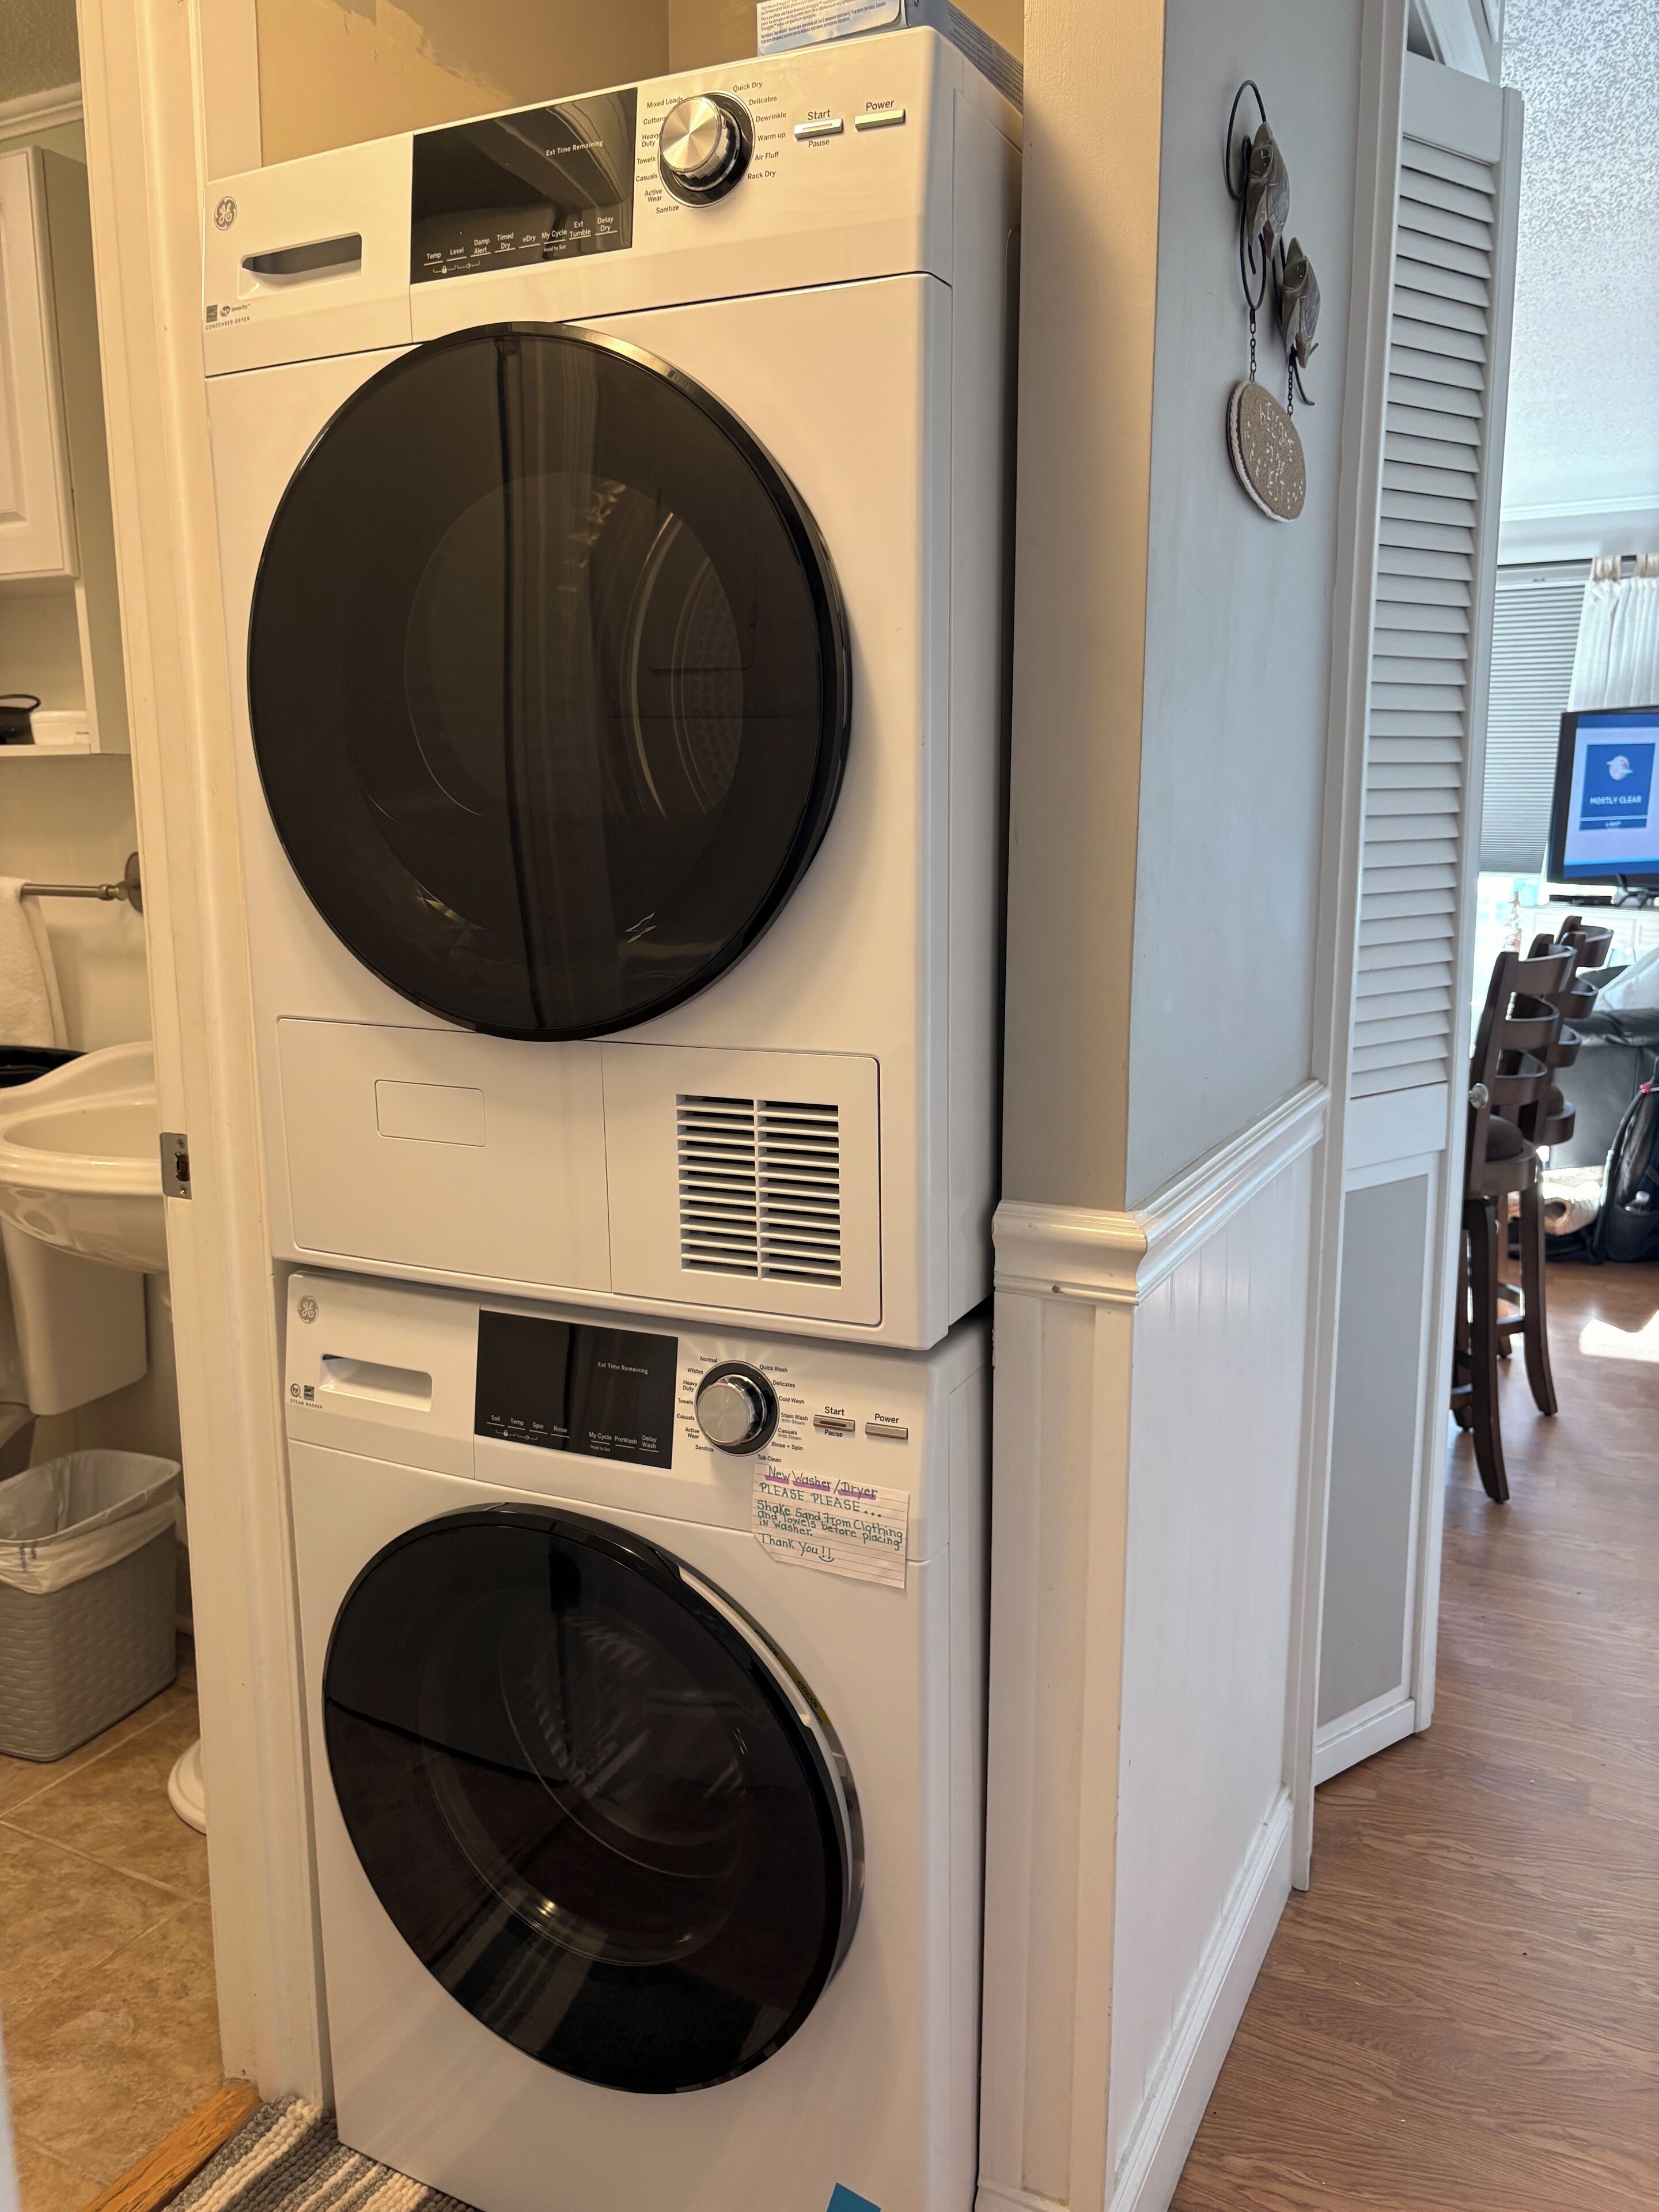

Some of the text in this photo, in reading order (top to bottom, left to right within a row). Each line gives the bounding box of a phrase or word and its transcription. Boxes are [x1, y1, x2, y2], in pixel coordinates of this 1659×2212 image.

[733, 84, 750, 93] Quick
[647, 97, 683, 109] Mixed Loads
[749, 96, 778, 106] Delicates
[866, 100, 895, 111] Power
[756, 112, 787, 122] Dewrinkle
[807, 109, 831, 120] Start
[642, 133, 660, 141] Heavy
[573, 141, 603, 151] Remaining
[808, 139, 830, 147] Pause
[637, 156, 656, 165] Towels
[636, 173, 658, 182] Casuals
[747, 171, 763, 180] Rack
[645, 189, 662, 197] Active
[656, 205, 680, 214] Sanitize
[497, 232, 514, 241] Timed
[551, 229, 567, 237] Cycle
[569, 229, 591, 237] Tumble
[450, 247, 464, 255] Level
[474, 247, 487, 255] Alert
[1590, 795, 1642, 805] MOSTLY CLEAR
[621, 1365, 649, 1375] Remaining
[772, 1380, 796, 1388] Delicates
[824, 1406, 845, 1416] Start
[874, 1413, 899, 1424] Power
[778, 1427, 798, 1435] Casuals
[824, 1429, 843, 1438] Pause
[614, 1435, 637, 1444] PreWash
[642, 1435, 657, 1444] Delay
[695, 1444, 714, 1452] Sanitize
[769, 1465, 790, 1480] New
[792, 1471, 831, 1488] Washer
[759, 1482, 804, 1501] PLEASE
[758, 1510, 900, 1551] and Towels before placing
[758, 1533, 794, 1549] Thank
